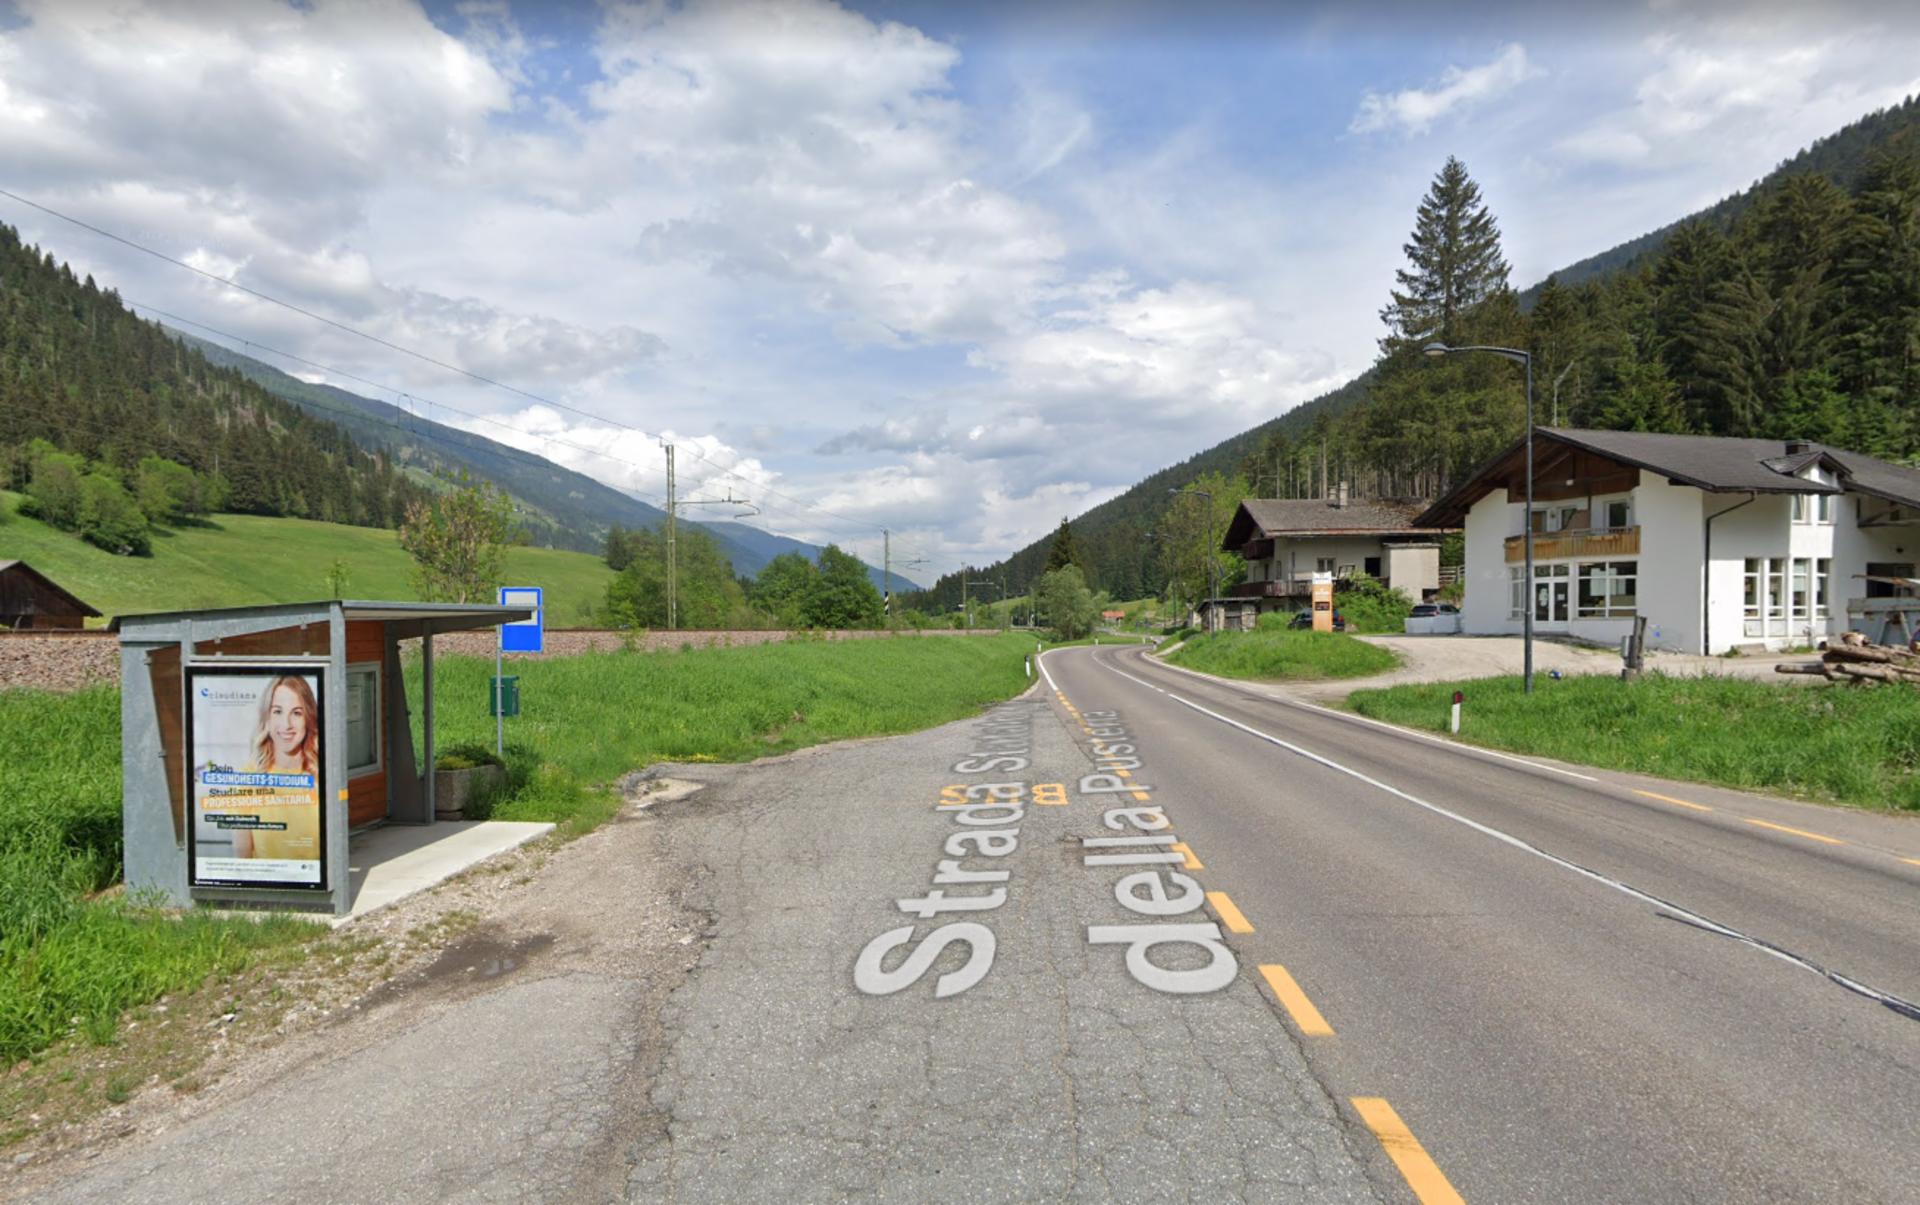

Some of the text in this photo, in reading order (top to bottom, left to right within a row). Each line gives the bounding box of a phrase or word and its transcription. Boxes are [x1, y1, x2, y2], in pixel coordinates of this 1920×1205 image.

[209, 764, 233, 773] Dein
[209, 787, 276, 798] Studiare una
[205, 797, 263, 808] PROFESSIONE
